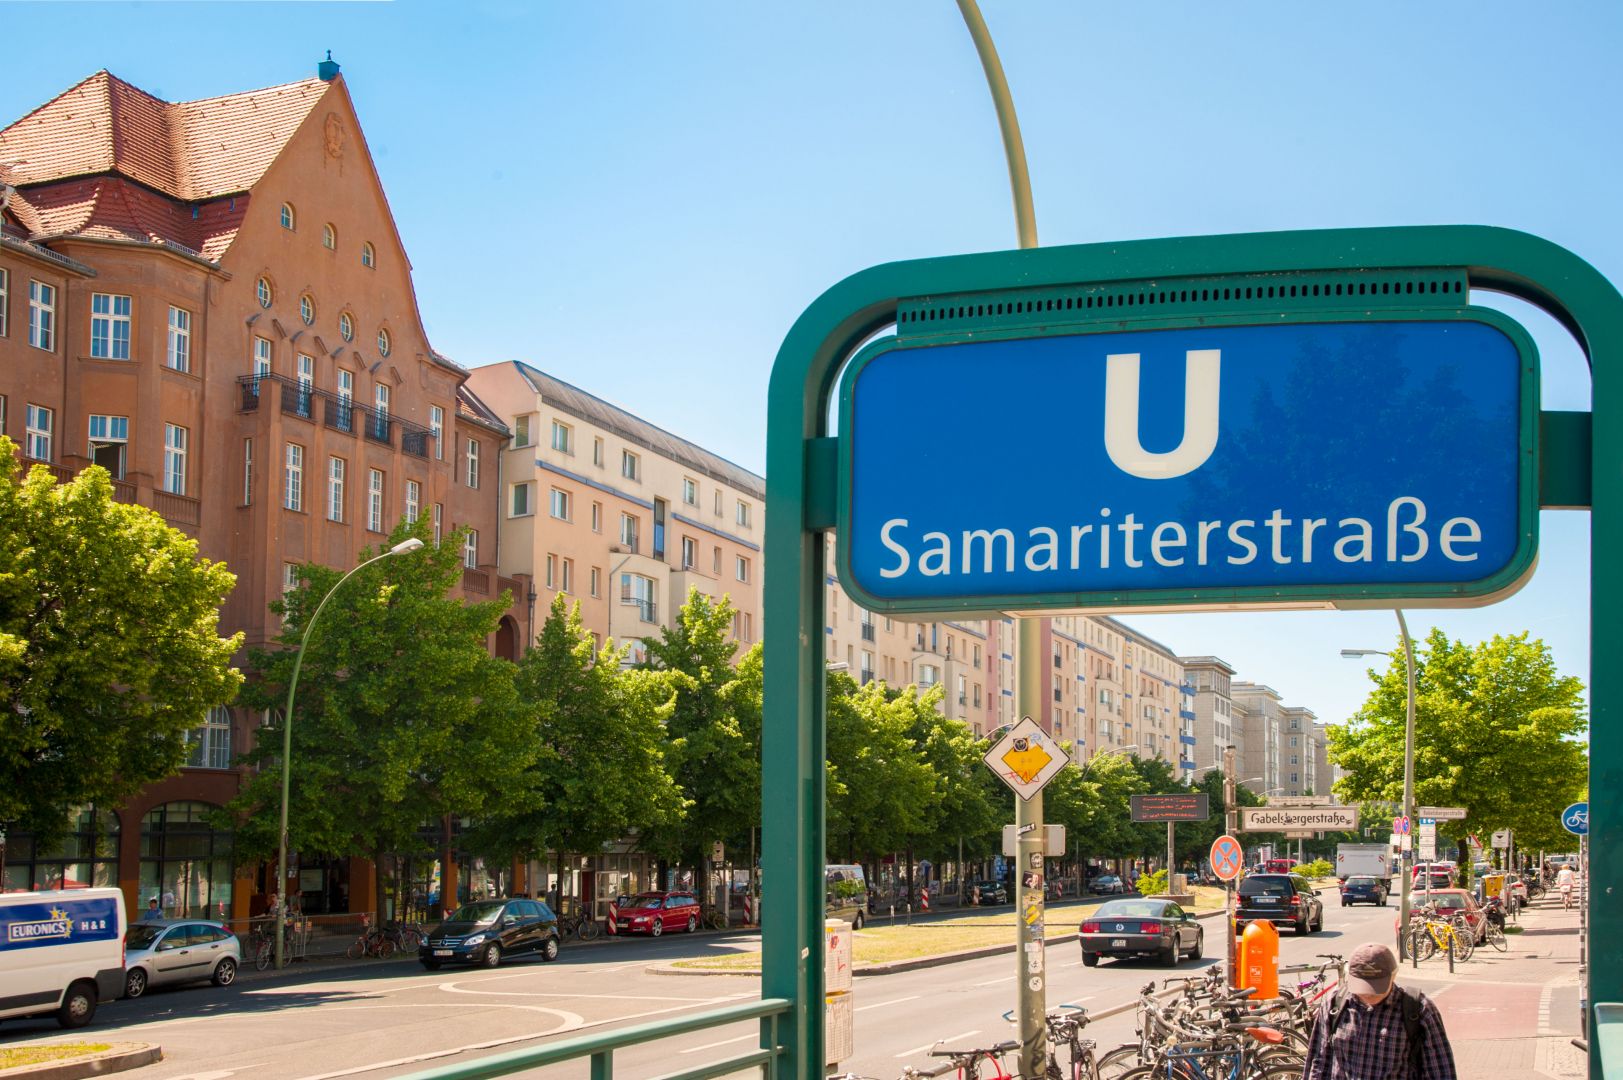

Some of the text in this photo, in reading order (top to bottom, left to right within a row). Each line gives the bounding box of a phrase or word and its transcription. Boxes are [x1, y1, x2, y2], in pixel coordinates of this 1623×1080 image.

[1104, 348, 1222, 480] U
[879, 495, 1482, 579] Samariterstraße
[12, 921, 66, 938] EURONICS
[81, 920, 106, 931] H & R
